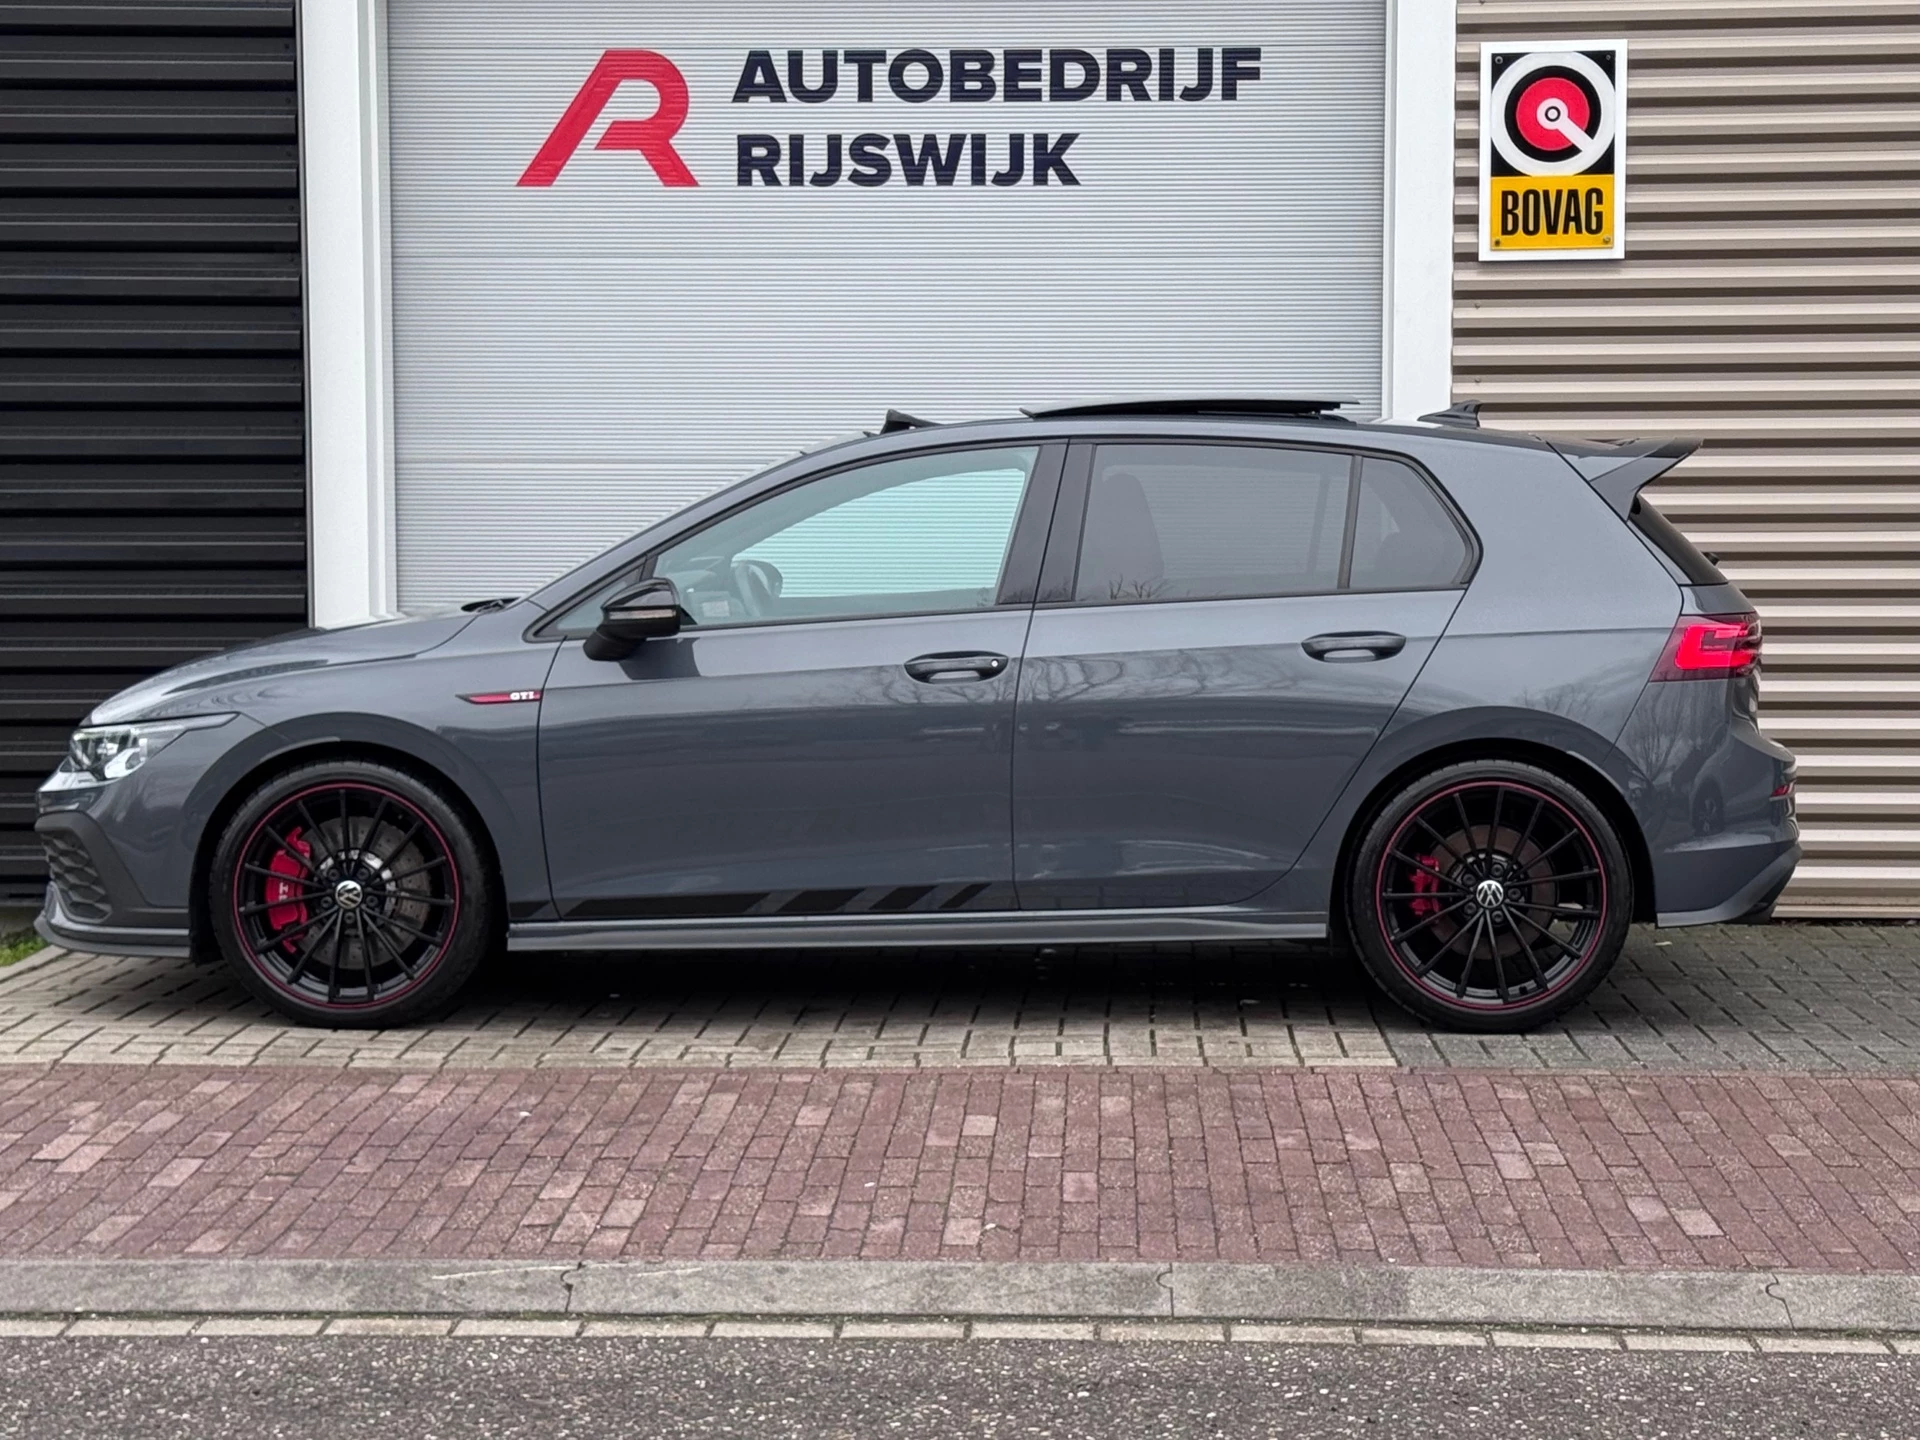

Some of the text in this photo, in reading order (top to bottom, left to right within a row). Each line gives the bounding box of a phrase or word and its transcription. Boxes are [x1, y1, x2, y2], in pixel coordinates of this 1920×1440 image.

[732, 47, 1262, 104] AUTOBEDRIJF
[736, 132, 1081, 187] RIJSWIJK
[1501, 187, 1604, 236] BOVAG
[509, 690, 535, 701] GTI
